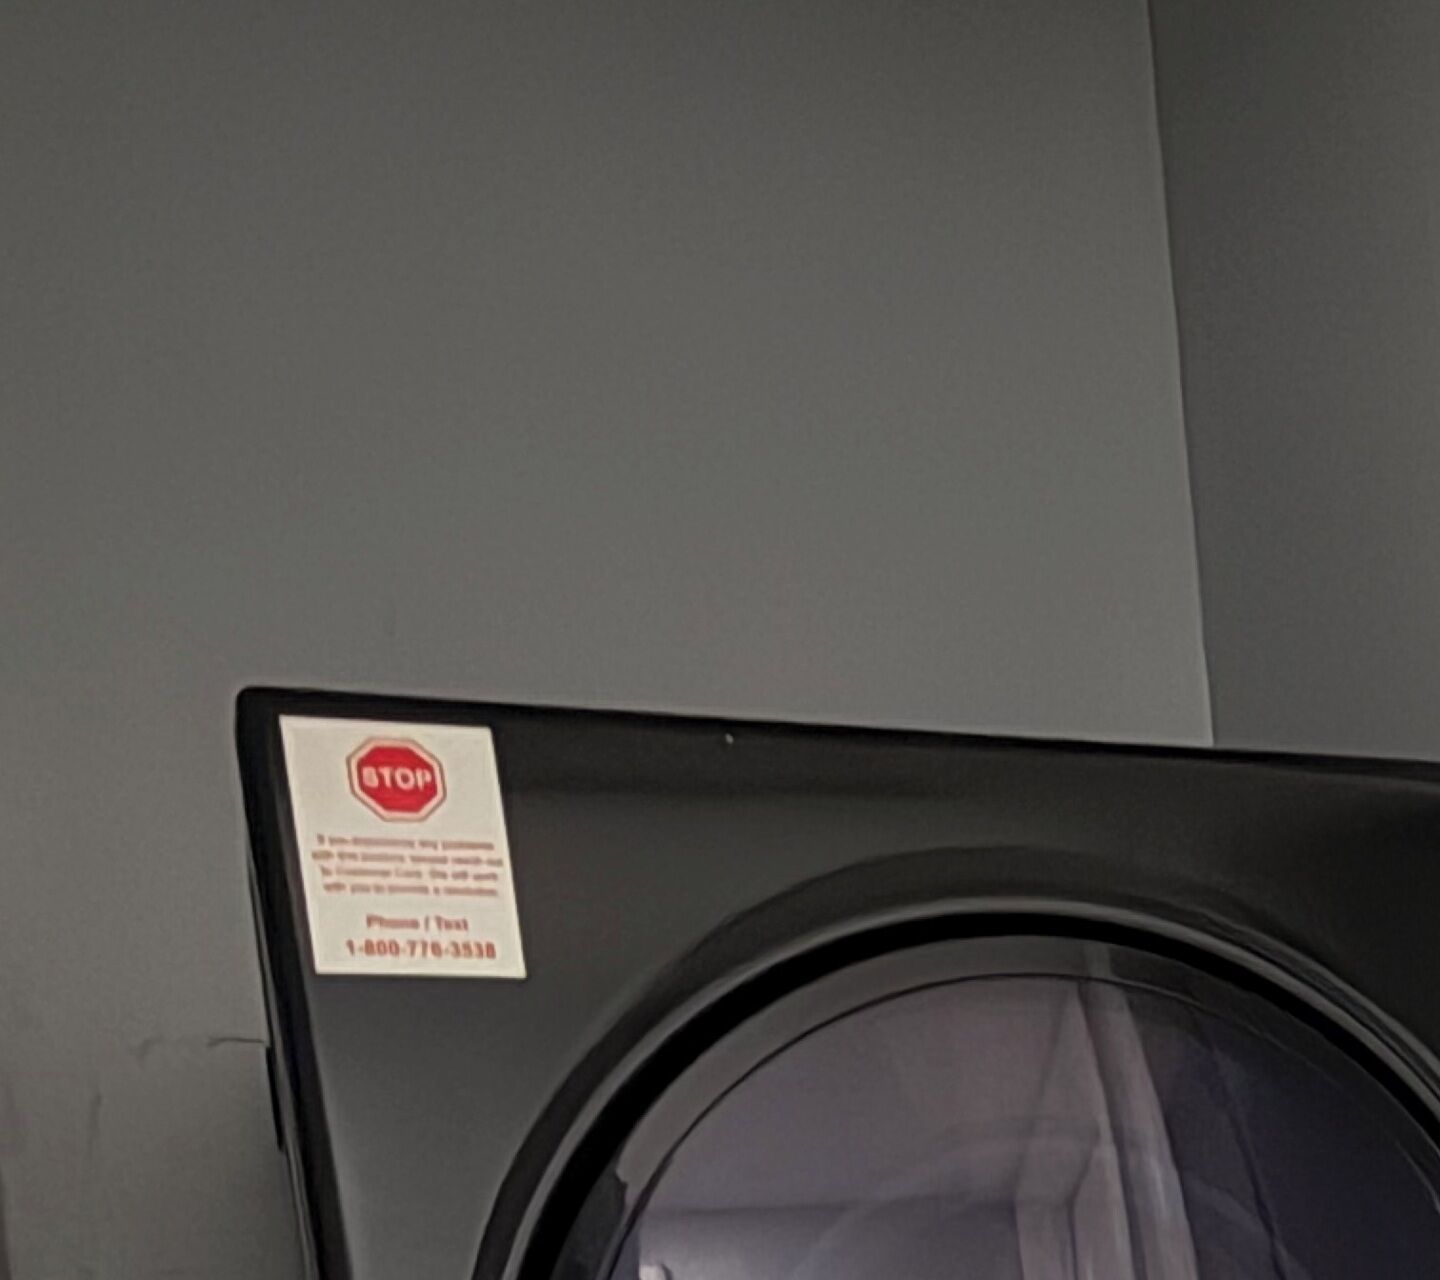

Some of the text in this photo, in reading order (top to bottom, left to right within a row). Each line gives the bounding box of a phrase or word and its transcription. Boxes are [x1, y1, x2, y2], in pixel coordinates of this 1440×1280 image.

[361, 765, 433, 791] STOP
[366, 914, 419, 930] Phone
[435, 915, 469, 931] Text
